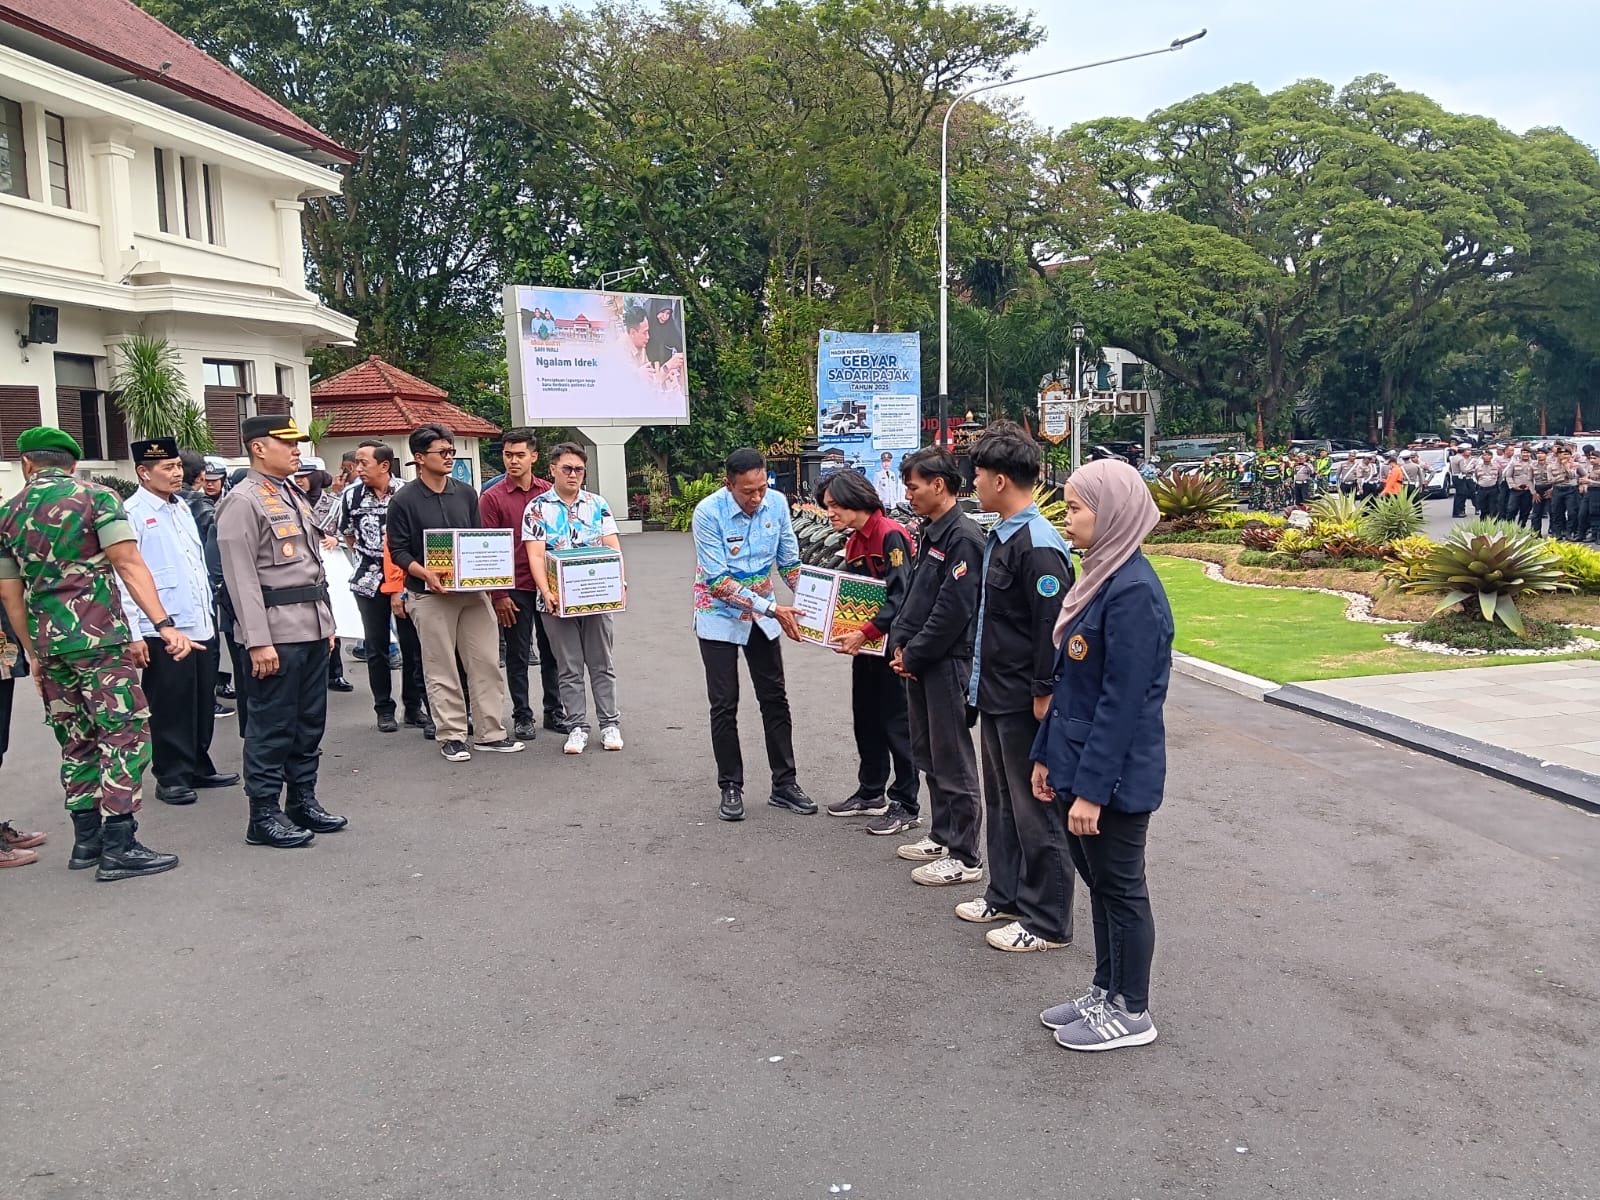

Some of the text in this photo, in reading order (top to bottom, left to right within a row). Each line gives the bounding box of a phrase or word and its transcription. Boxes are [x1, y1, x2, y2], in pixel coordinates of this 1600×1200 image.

[536, 356, 598, 368] Ngalam Idrek
[842, 355, 897, 367] GEBYAR
[828, 369, 910, 380] SADAR PAJAK
[1092, 393, 1147, 413] UGU
